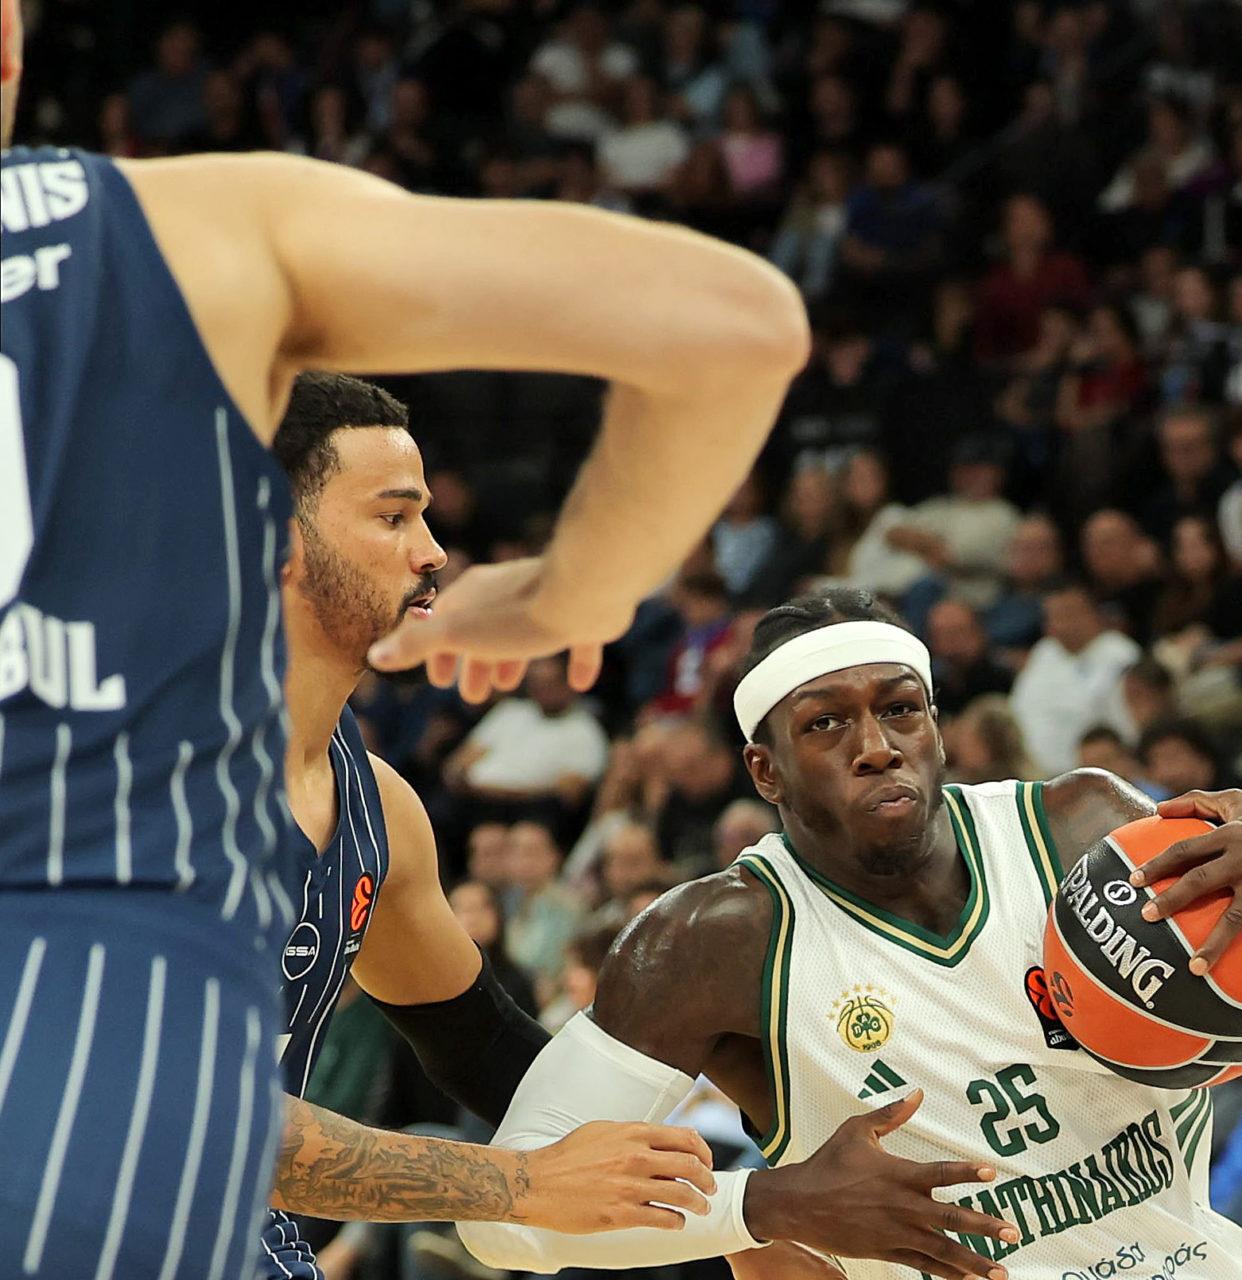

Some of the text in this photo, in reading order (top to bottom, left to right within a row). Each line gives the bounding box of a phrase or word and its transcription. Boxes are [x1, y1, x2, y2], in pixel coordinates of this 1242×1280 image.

[285, 946, 317, 957] GSA
[1060, 853, 1176, 1008] PALDING
[966, 1063, 1060, 1157] 25
